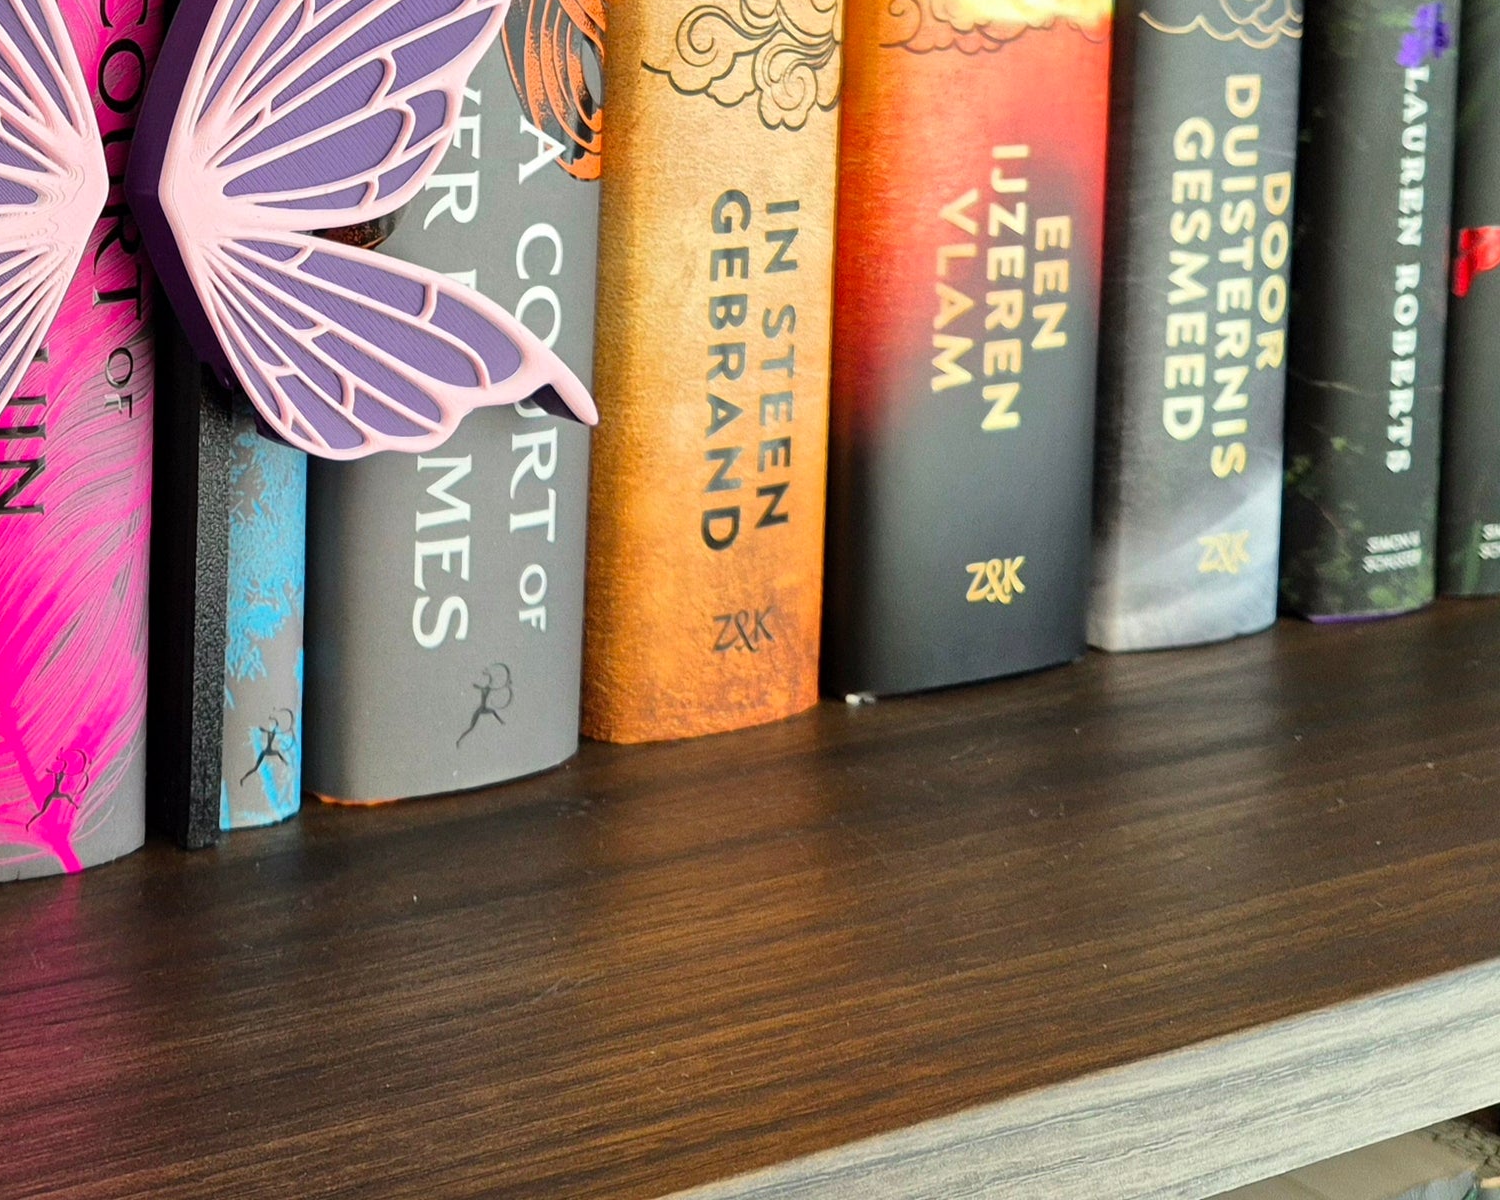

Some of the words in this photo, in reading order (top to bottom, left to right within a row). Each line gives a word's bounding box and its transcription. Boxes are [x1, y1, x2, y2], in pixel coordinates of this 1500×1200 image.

[518, 115, 568, 185] A
[763, 199, 801, 273] IN
[1395, 66, 1431, 247] LAUREN
[701, 188, 752, 552] GEBRAND
[931, 187, 980, 392] VLAM
[981, 143, 1031, 431] IJZEREN
[1031, 214, 1072, 350] EEN
[1162, 116, 1216, 442] GESMEED
[1210, 73, 1263, 478] DUISTERNIS
[1255, 171, 1292, 370] DOOR
[1384, 262, 1421, 474] ROBERTS
[102, 346, 135, 420] OF
[509, 222, 565, 543] CORT
[755, 303, 798, 529] STEEN
[518, 562, 549, 633] OF
[713, 605, 776, 653] Z&K
[966, 555, 1027, 604] Z&K
